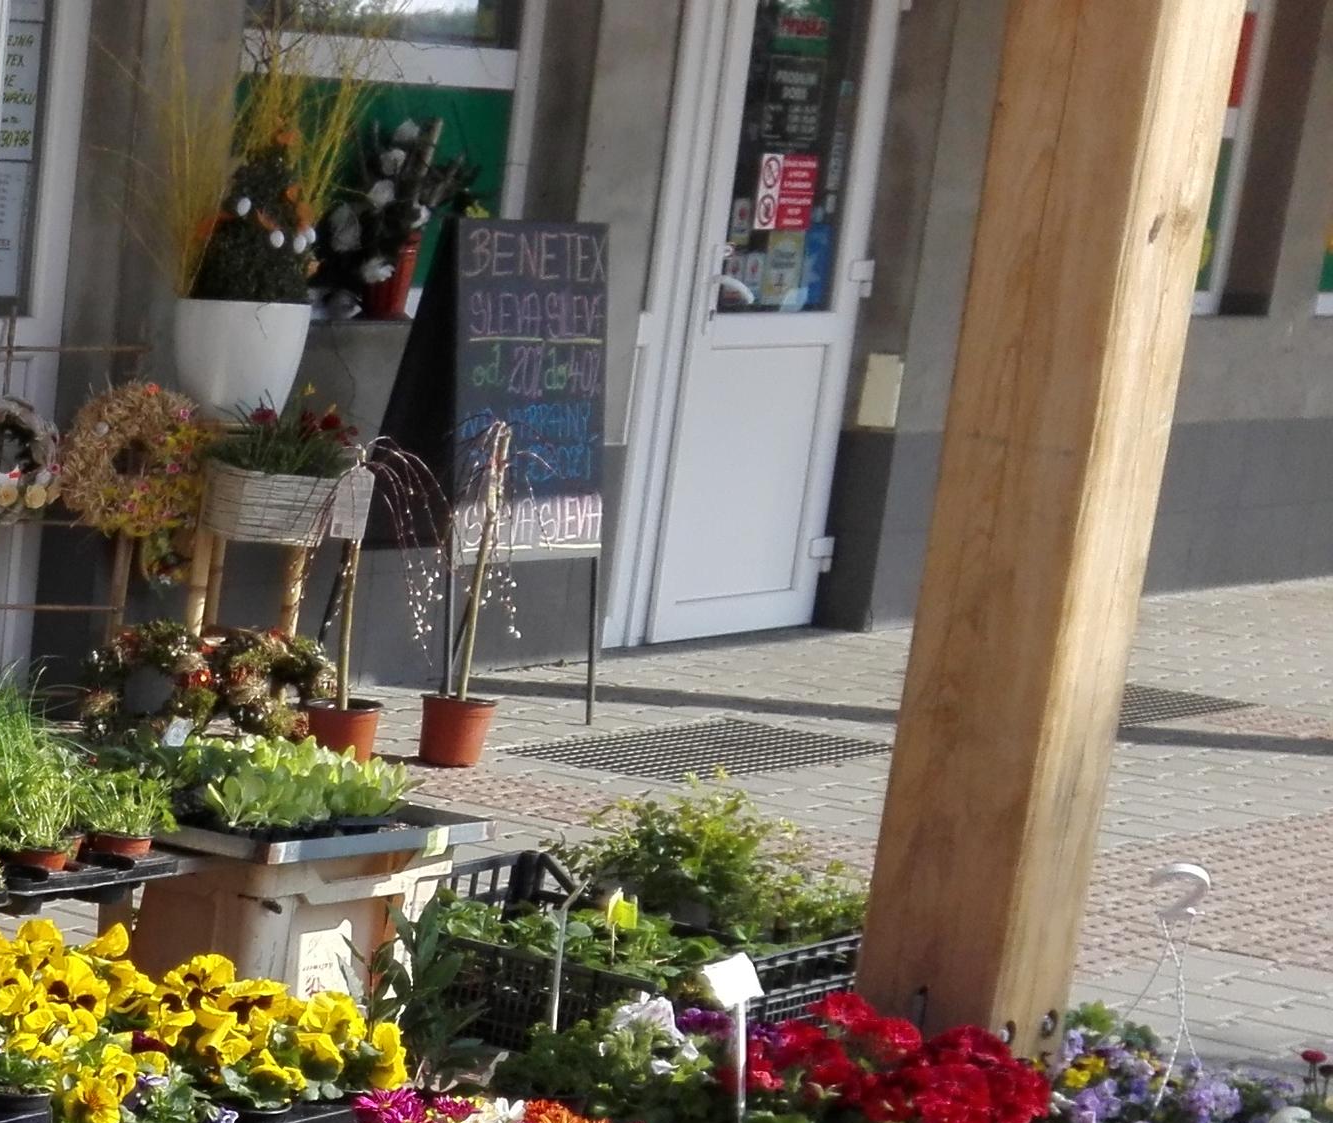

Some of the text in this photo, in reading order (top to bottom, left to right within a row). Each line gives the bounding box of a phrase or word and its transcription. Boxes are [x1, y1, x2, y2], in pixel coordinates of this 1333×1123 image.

[6, 34, 35, 47] EJNA
[461, 228, 607, 283] BENETEX
[469, 291, 543, 336] SLEVA
[539, 492, 603, 542] SLEVA
